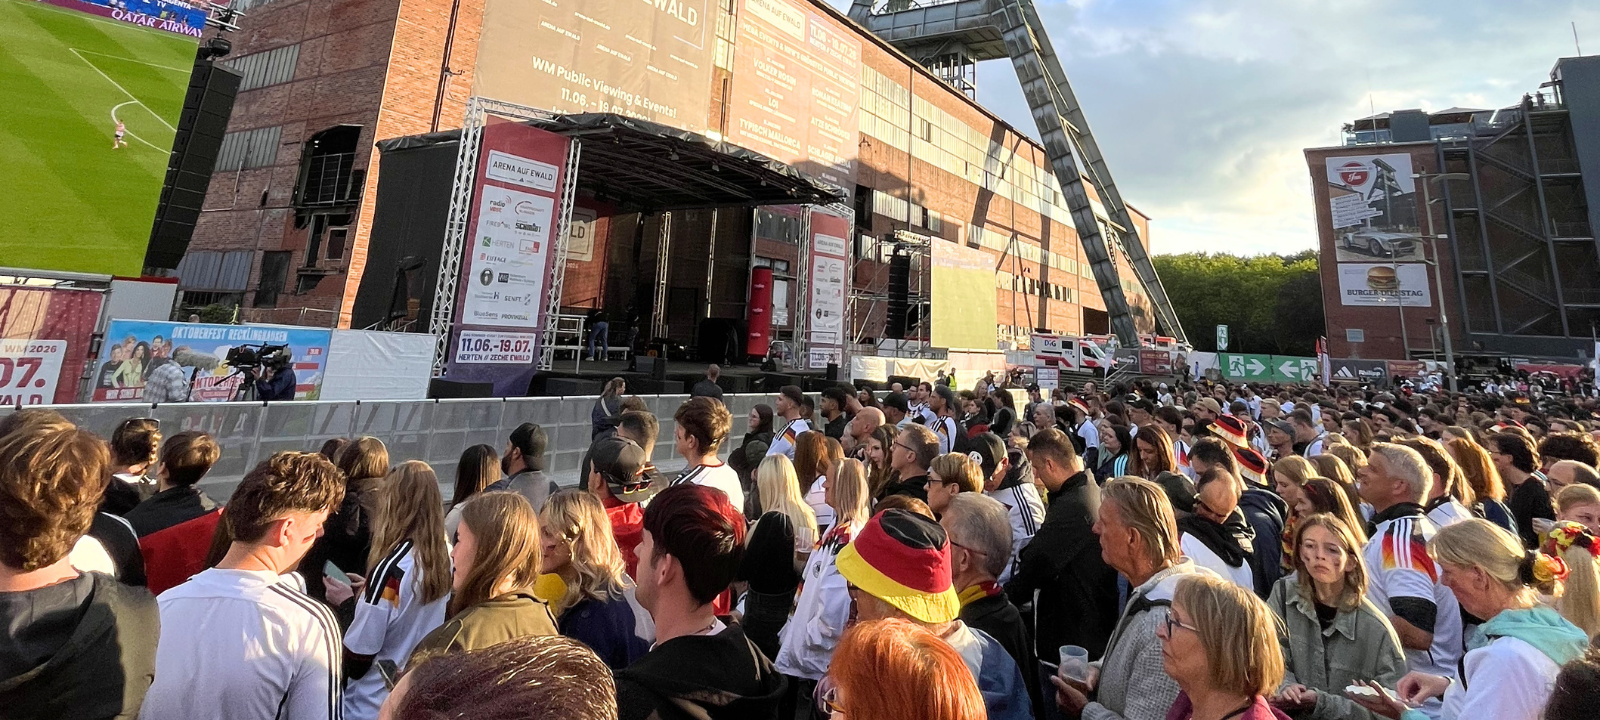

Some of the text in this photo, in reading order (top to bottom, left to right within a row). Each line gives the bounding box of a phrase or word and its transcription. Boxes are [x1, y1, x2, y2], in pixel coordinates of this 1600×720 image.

[111, 9, 155, 27] QATAR
[771, 5, 783, 18] AUF
[782, 13, 801, 29] EWALD
[753, 57, 778, 78] VOLKER
[532, 55, 677, 119] WM Public Viewing & Events!
[560, 87, 589, 108] 11.06.
[739, 117, 768, 138] TYPISCH
[767, 128, 801, 150] MALLORCA
[493, 161, 553, 181] ARENA AUF EWALD
[489, 200, 506, 208] radio
[492, 240, 514, 249] HERTEN
[486, 255, 507, 263] EIFFAGE
[474, 310, 498, 318] BlueSens
[171, 326, 289, 342] OKTOBERFEST RECKLINGHAUSEN
[4, 345, 58, 354] WM 2026
[461, 338, 531, 353] 11.06.-19.07.
[459, 353, 483, 361] HERTEN
[0, 394, 43, 404] ALD
